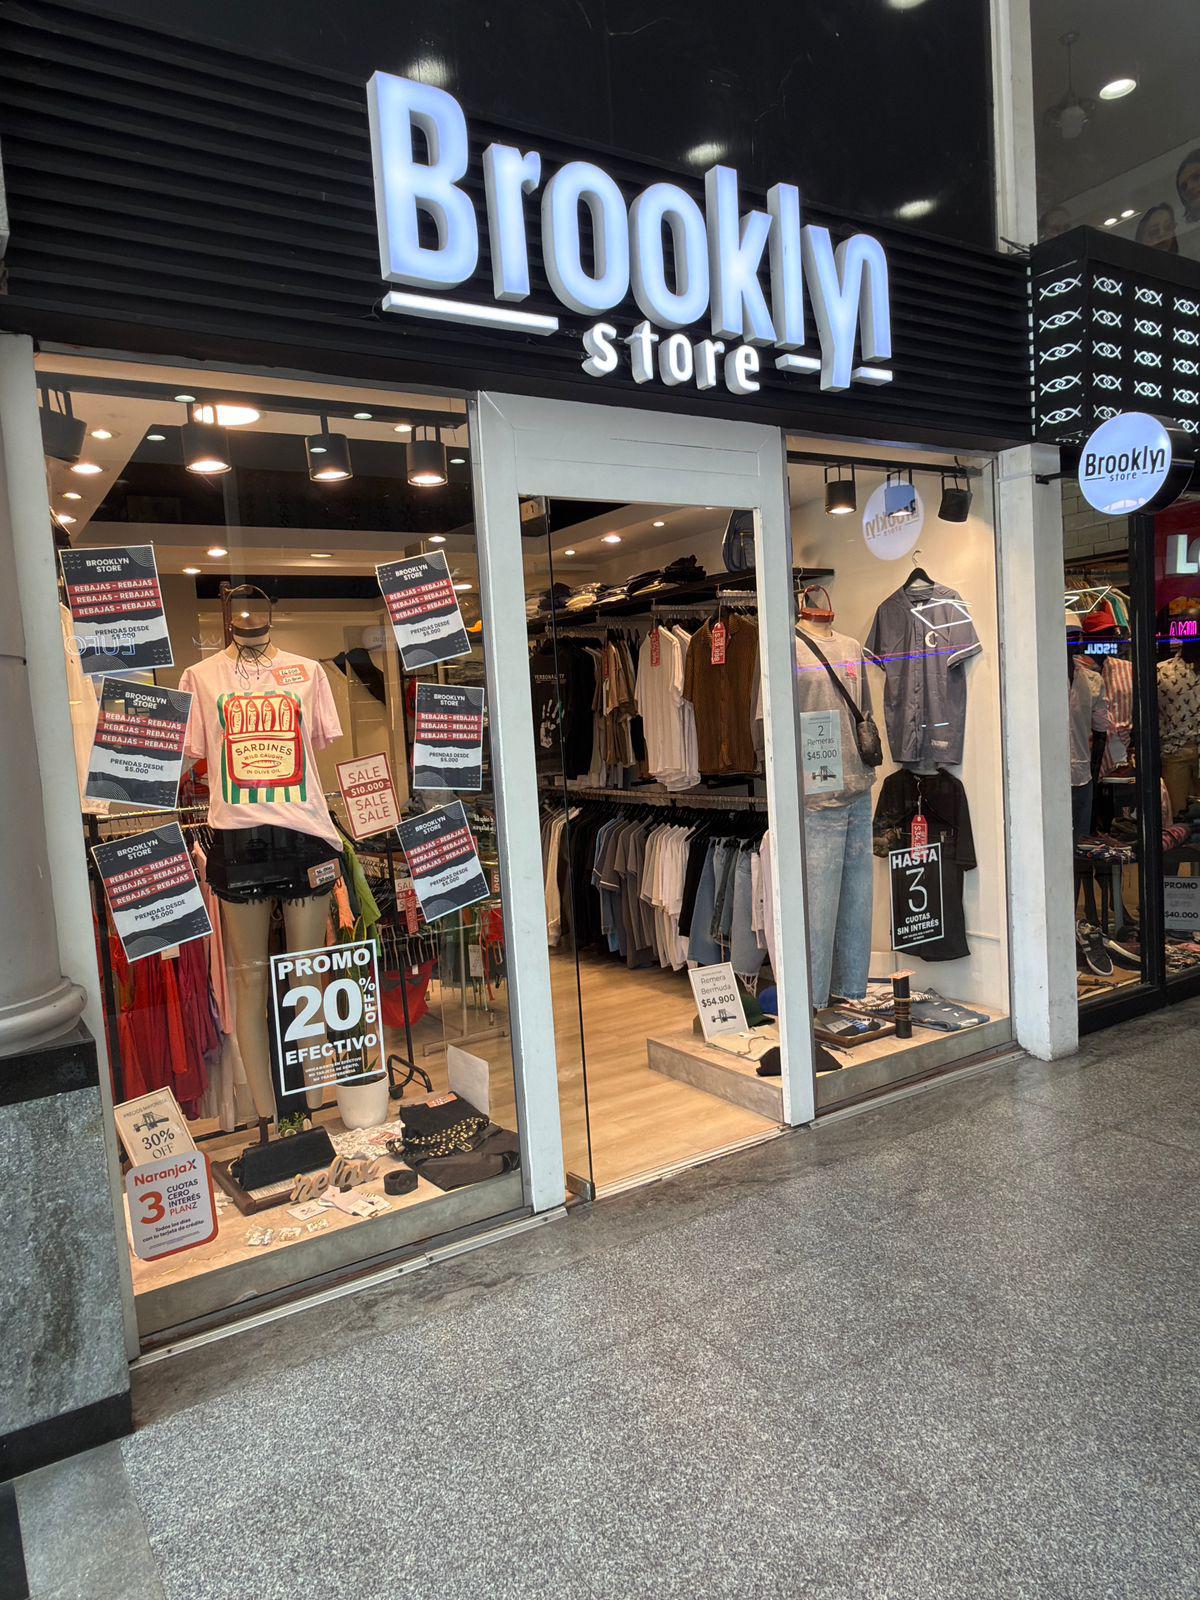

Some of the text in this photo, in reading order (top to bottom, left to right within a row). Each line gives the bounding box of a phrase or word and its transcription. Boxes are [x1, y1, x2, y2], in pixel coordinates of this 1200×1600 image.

[366, 70, 892, 392] Brooklyn
[582, 320, 760, 394] store
[1085, 445, 1165, 477] Brooklyn
[1109, 472, 1137, 482] store
[86, 558, 129, 567] BROOKLYN
[395, 564, 428, 577] BROOKLYN
[404, 572, 423, 581] STORE
[74, 583, 110, 593] REBAJAS
[118, 580, 152, 588] REBAJAS
[389, 588, 416, 600] REBAJAS
[421, 580, 447, 591] REBAJAS
[77, 594, 112, 603] REBAJAS
[120, 590, 154, 599] REBAJAS
[392, 598, 419, 609] REBAJAS
[424, 590, 450, 601] REBAJAS
[79, 605, 115, 615] REBAJAS
[122, 601, 156, 610] REBAJAS
[396, 607, 422, 619] REBAJAS
[427, 598, 453, 610] REBAJAS
[125, 692, 167, 704] BROOKLYN
[133, 700, 157, 710] STORE
[105, 712, 141, 724] REBAJAS
[148, 719, 182, 730] REBAJAS
[104, 723, 139, 734] REBAJAS
[146, 730, 180, 740] REBAJAS
[818, 725, 824, 736] 2
[102, 734, 137, 744] REBAJAS
[144, 740, 178, 750] REBAJAS
[236, 744, 292, 755] SARDINES
[807, 750, 837, 760] $45.000
[110, 758, 164, 771] PRENDAS DESDE
[124, 766, 149, 774] $5.000
[349, 766, 381, 784] SALE
[351, 782, 384, 796] $10.000
[356, 793, 387, 811] SALE
[359, 806, 391, 824] SALE
[415, 816, 446, 832] BROOKLYN
[423, 824, 441, 835] STORE
[117, 839, 159, 857] BROOKLYN
[410, 841, 435, 856] REBAJAS
[440, 829, 465, 843] REBAJAS
[413, 850, 438, 864] REBAJAS
[443, 837, 468, 851] REBAJAS
[128, 848, 152, 860] STORE
[416, 859, 441, 873] REBAJAS
[446, 846, 470, 860] REBAJAS
[892, 848, 938, 870] HASTA
[110, 867, 143, 884] REBAJAS
[150, 854, 183, 871] REBAJAS
[112, 878, 147, 894] REBAJAS
[153, 864, 186, 881] REBAJAS
[116, 889, 150, 905] REBAJAS
[157, 874, 190, 891] REBAJAS
[906, 867, 928, 912] 3
[134, 899, 186, 921] PRENDAS DESDE
[151, 910, 174, 921] $5.000
[905, 912, 930, 924] CUOTAS
[897, 926, 909, 935] SIN
[911, 918, 939, 932] INTERÉS
[278, 948, 370, 980] PROMO
[701, 974, 726, 984] Remera
[701, 985, 731, 995] Bermuda
[364, 993, 376, 1024] OFF
[701, 993, 736, 1008] $54.900
[286, 1033, 377, 1065] EFECTIVO
[142, 1128, 174, 1150] 30%
[153, 1142, 173, 1158] OFF
[167, 1179, 198, 1193] CUOTAS
[167, 1189, 190, 1200] CERO
[169, 1192, 201, 1208] INTERÉS
[139, 1191, 165, 1224] 3
[160, 1228, 177, 1237] tarjeta
[186, 1220, 204, 1229] crédito
